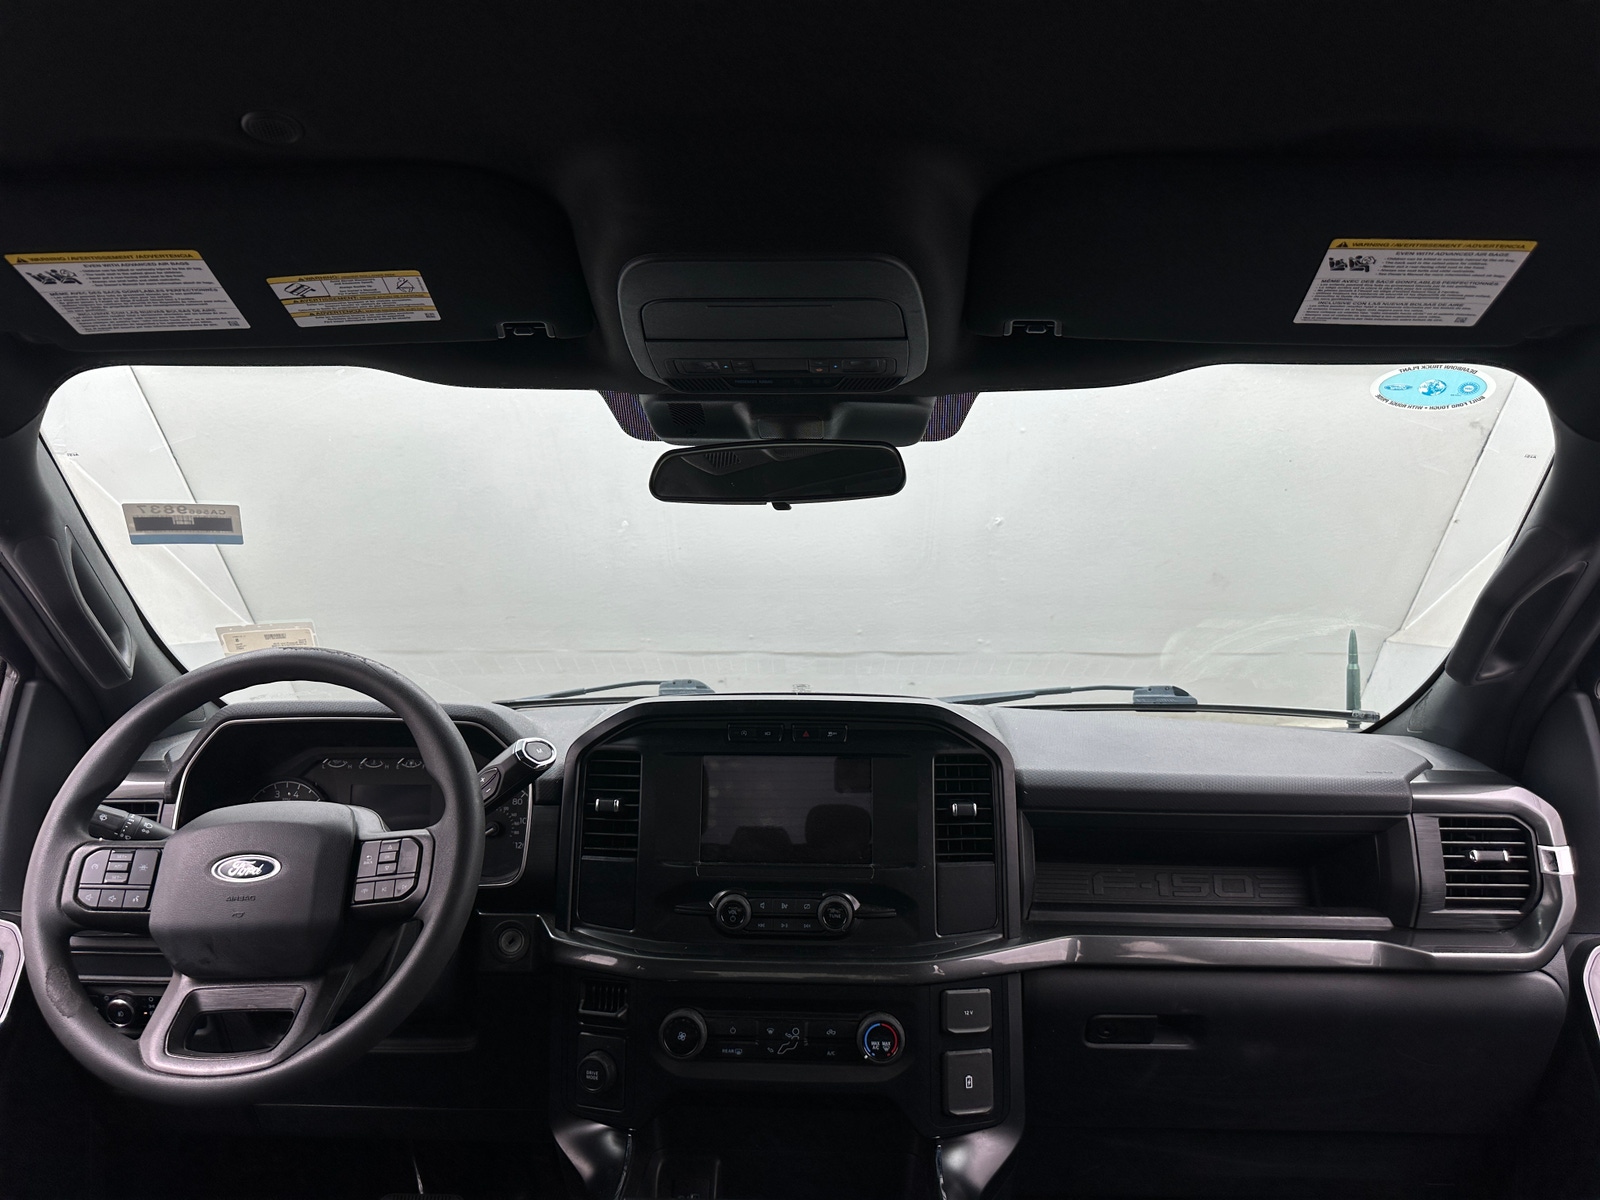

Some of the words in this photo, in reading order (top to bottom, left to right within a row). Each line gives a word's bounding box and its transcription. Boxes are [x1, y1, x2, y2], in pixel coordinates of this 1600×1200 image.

[274, 790, 281, 798] 3
[293, 790, 300, 798] 4
[511, 797, 523, 806] 80
[514, 841, 524, 850] 12
[228, 860, 264, 876] Ford
[1091, 870, 1255, 899] F-150
